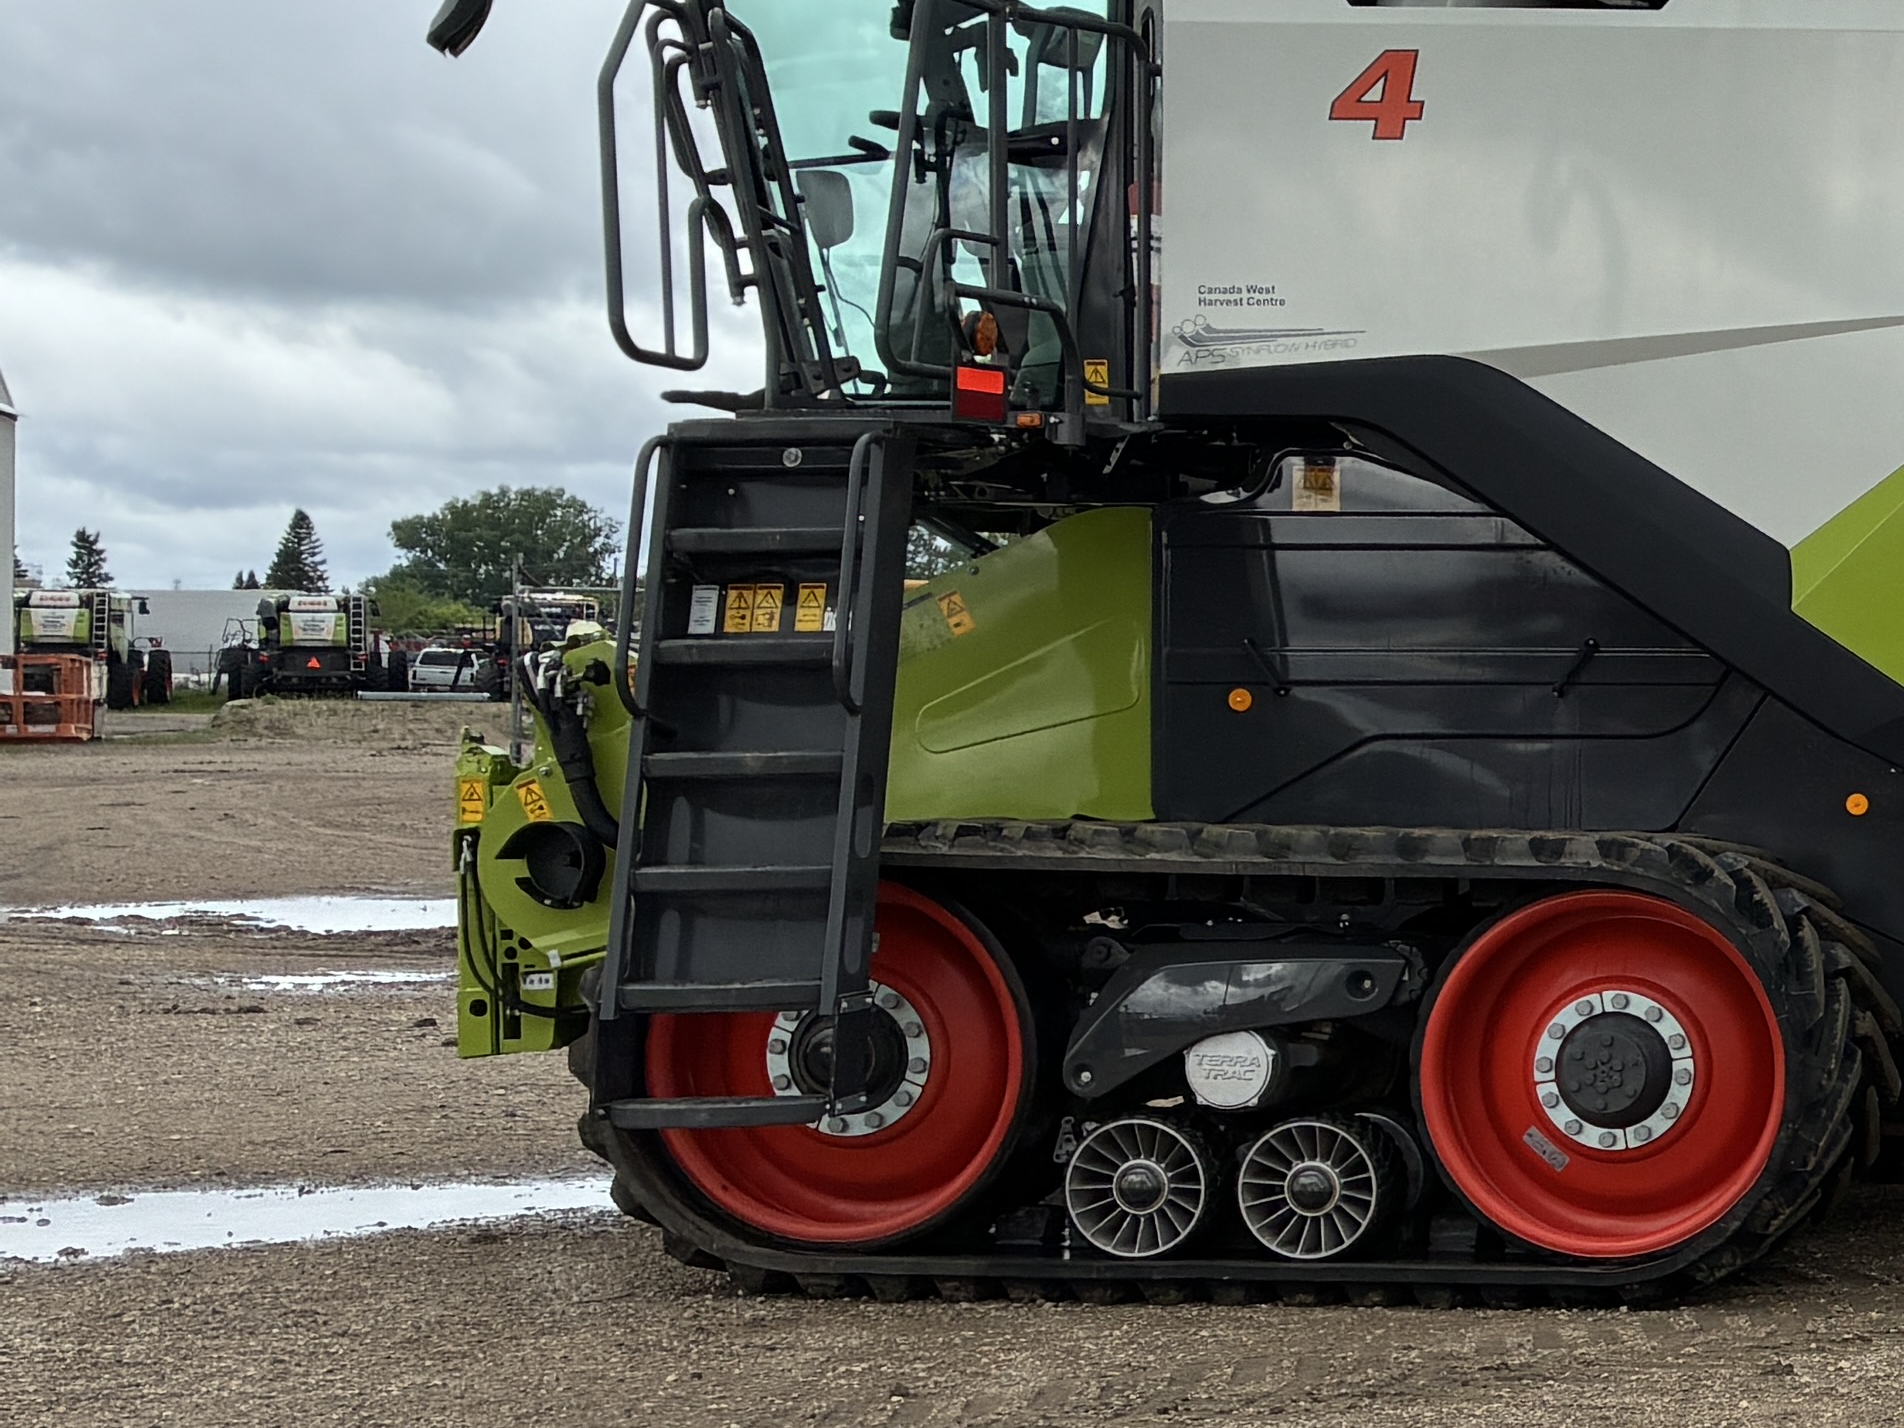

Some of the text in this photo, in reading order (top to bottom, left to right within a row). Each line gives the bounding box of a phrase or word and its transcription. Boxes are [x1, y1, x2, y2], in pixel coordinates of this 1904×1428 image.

[1329, 49, 1425, 140] 4
[1198, 285, 1275, 295] Canada West
[1198, 297, 1286, 307] Harvest Centre
[1177, 348, 1227, 366] APS
[1193, 1054, 1261, 1068] TERRA
[1202, 1068, 1255, 1081] TRAC
